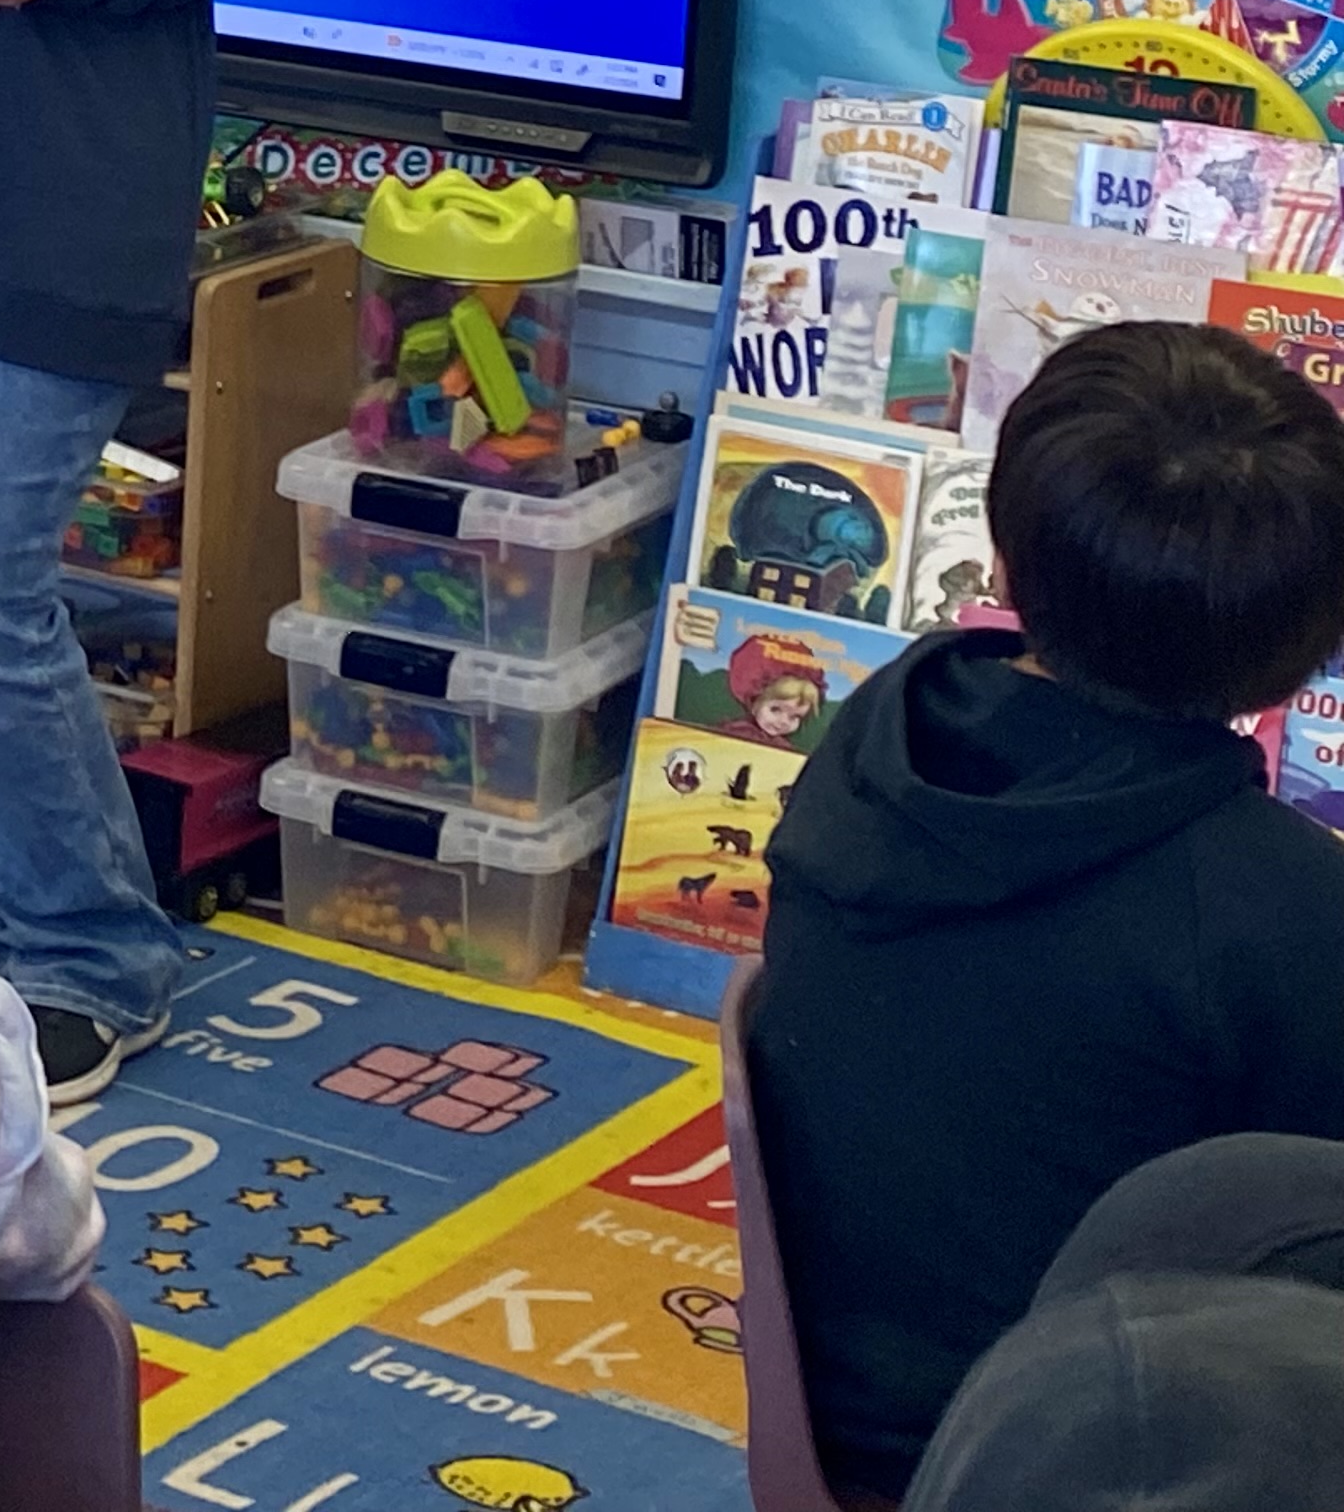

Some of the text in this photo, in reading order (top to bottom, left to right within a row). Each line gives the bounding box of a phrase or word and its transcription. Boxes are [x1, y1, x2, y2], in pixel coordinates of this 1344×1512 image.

[1286, 39, 1339, 87] Stormy
[1096, 170, 1153, 208] BAD
[1031, 258, 1197, 306] SNOWMAN
[772, 473, 853, 503] The Dark
[205, 978, 360, 1040] 5
[162, 1028, 274, 1073] five
[349, 1346, 559, 1430] lemon
